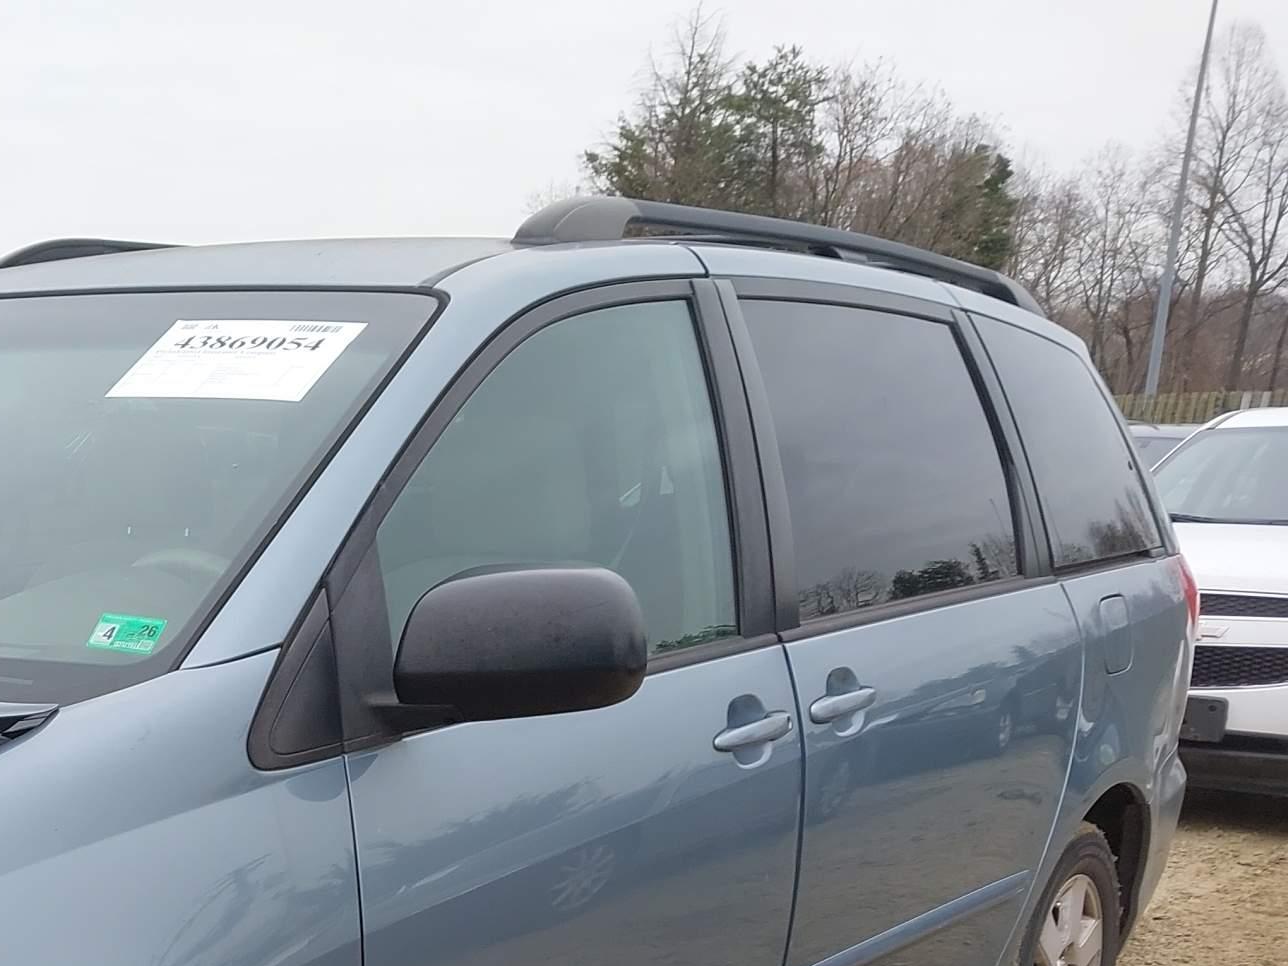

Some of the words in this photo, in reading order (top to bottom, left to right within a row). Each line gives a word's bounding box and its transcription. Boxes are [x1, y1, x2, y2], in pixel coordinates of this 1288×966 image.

[173, 335, 326, 351] 43869054
[102, 626, 116, 640] 4
[137, 624, 159, 638] 26
